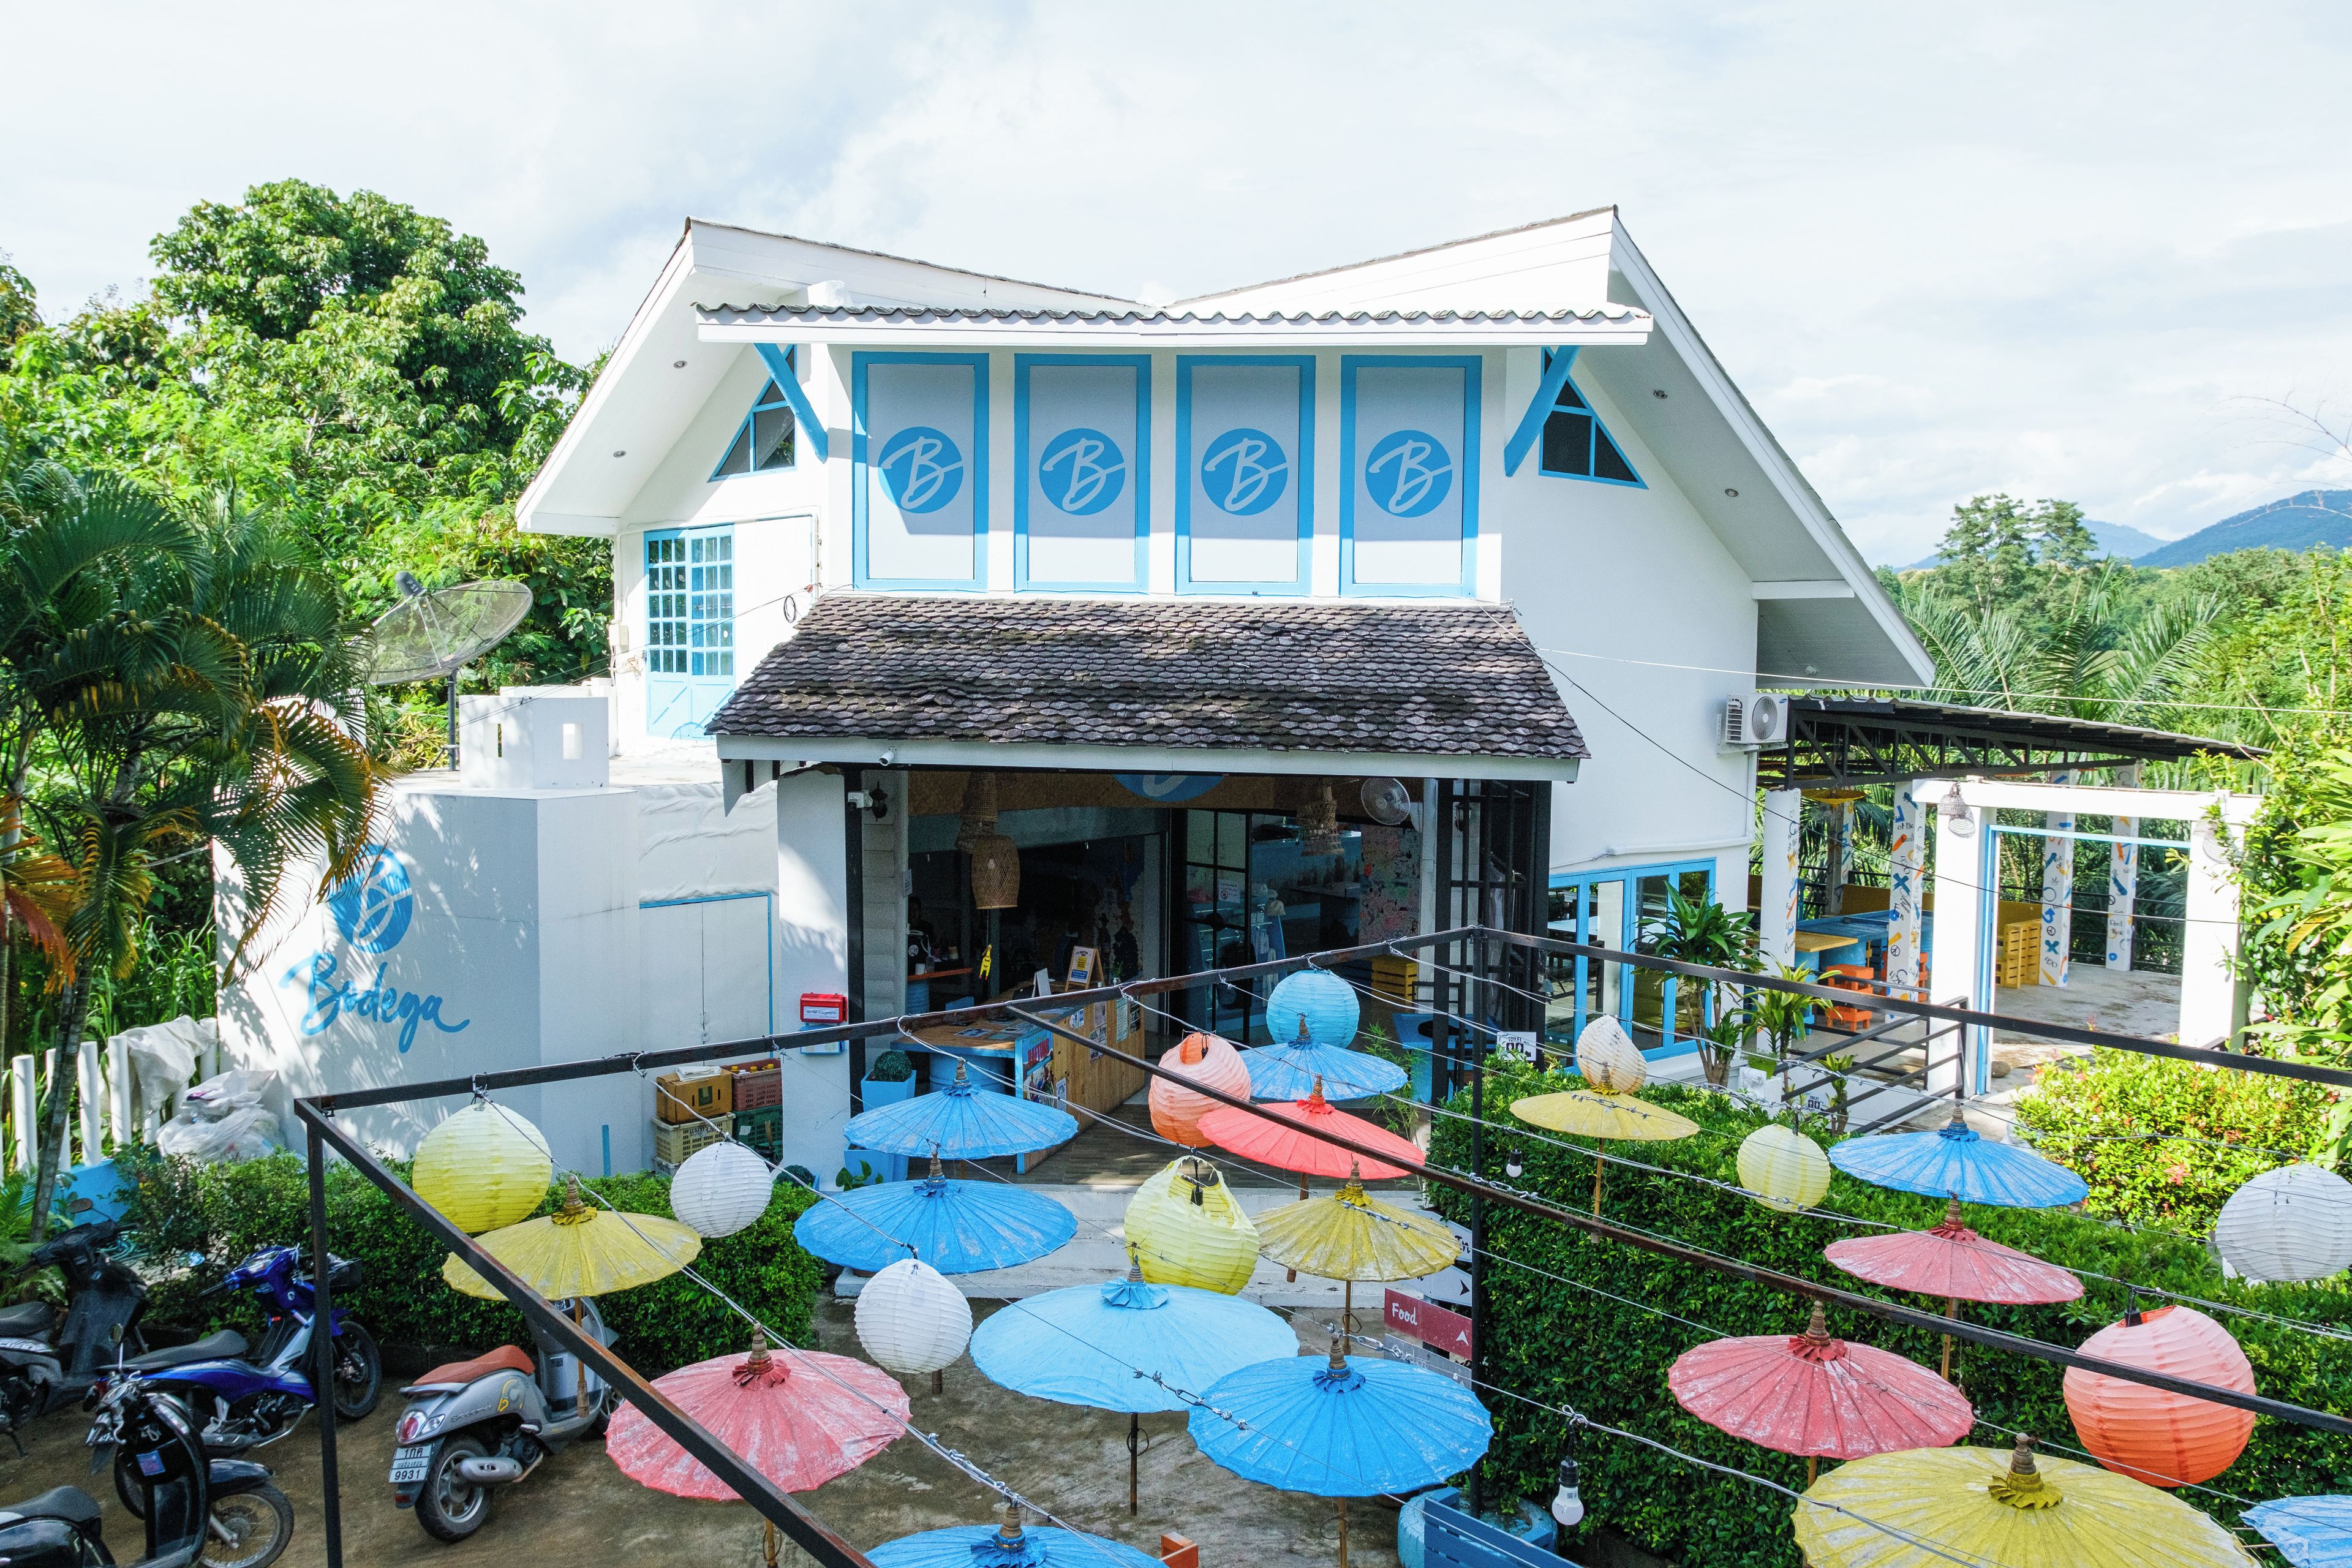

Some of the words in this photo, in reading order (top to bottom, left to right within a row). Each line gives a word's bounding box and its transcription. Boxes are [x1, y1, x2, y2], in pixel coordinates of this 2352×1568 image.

[883, 436, 963, 510] B
[1043, 437, 1126, 511] B
[1205, 437, 1288, 511] B
[1370, 439, 1453, 514] B
[279, 951, 471, 1054] Bodega
[1392, 1302, 1418, 1326] Food
[394, 1469, 421, 1480] 9931
